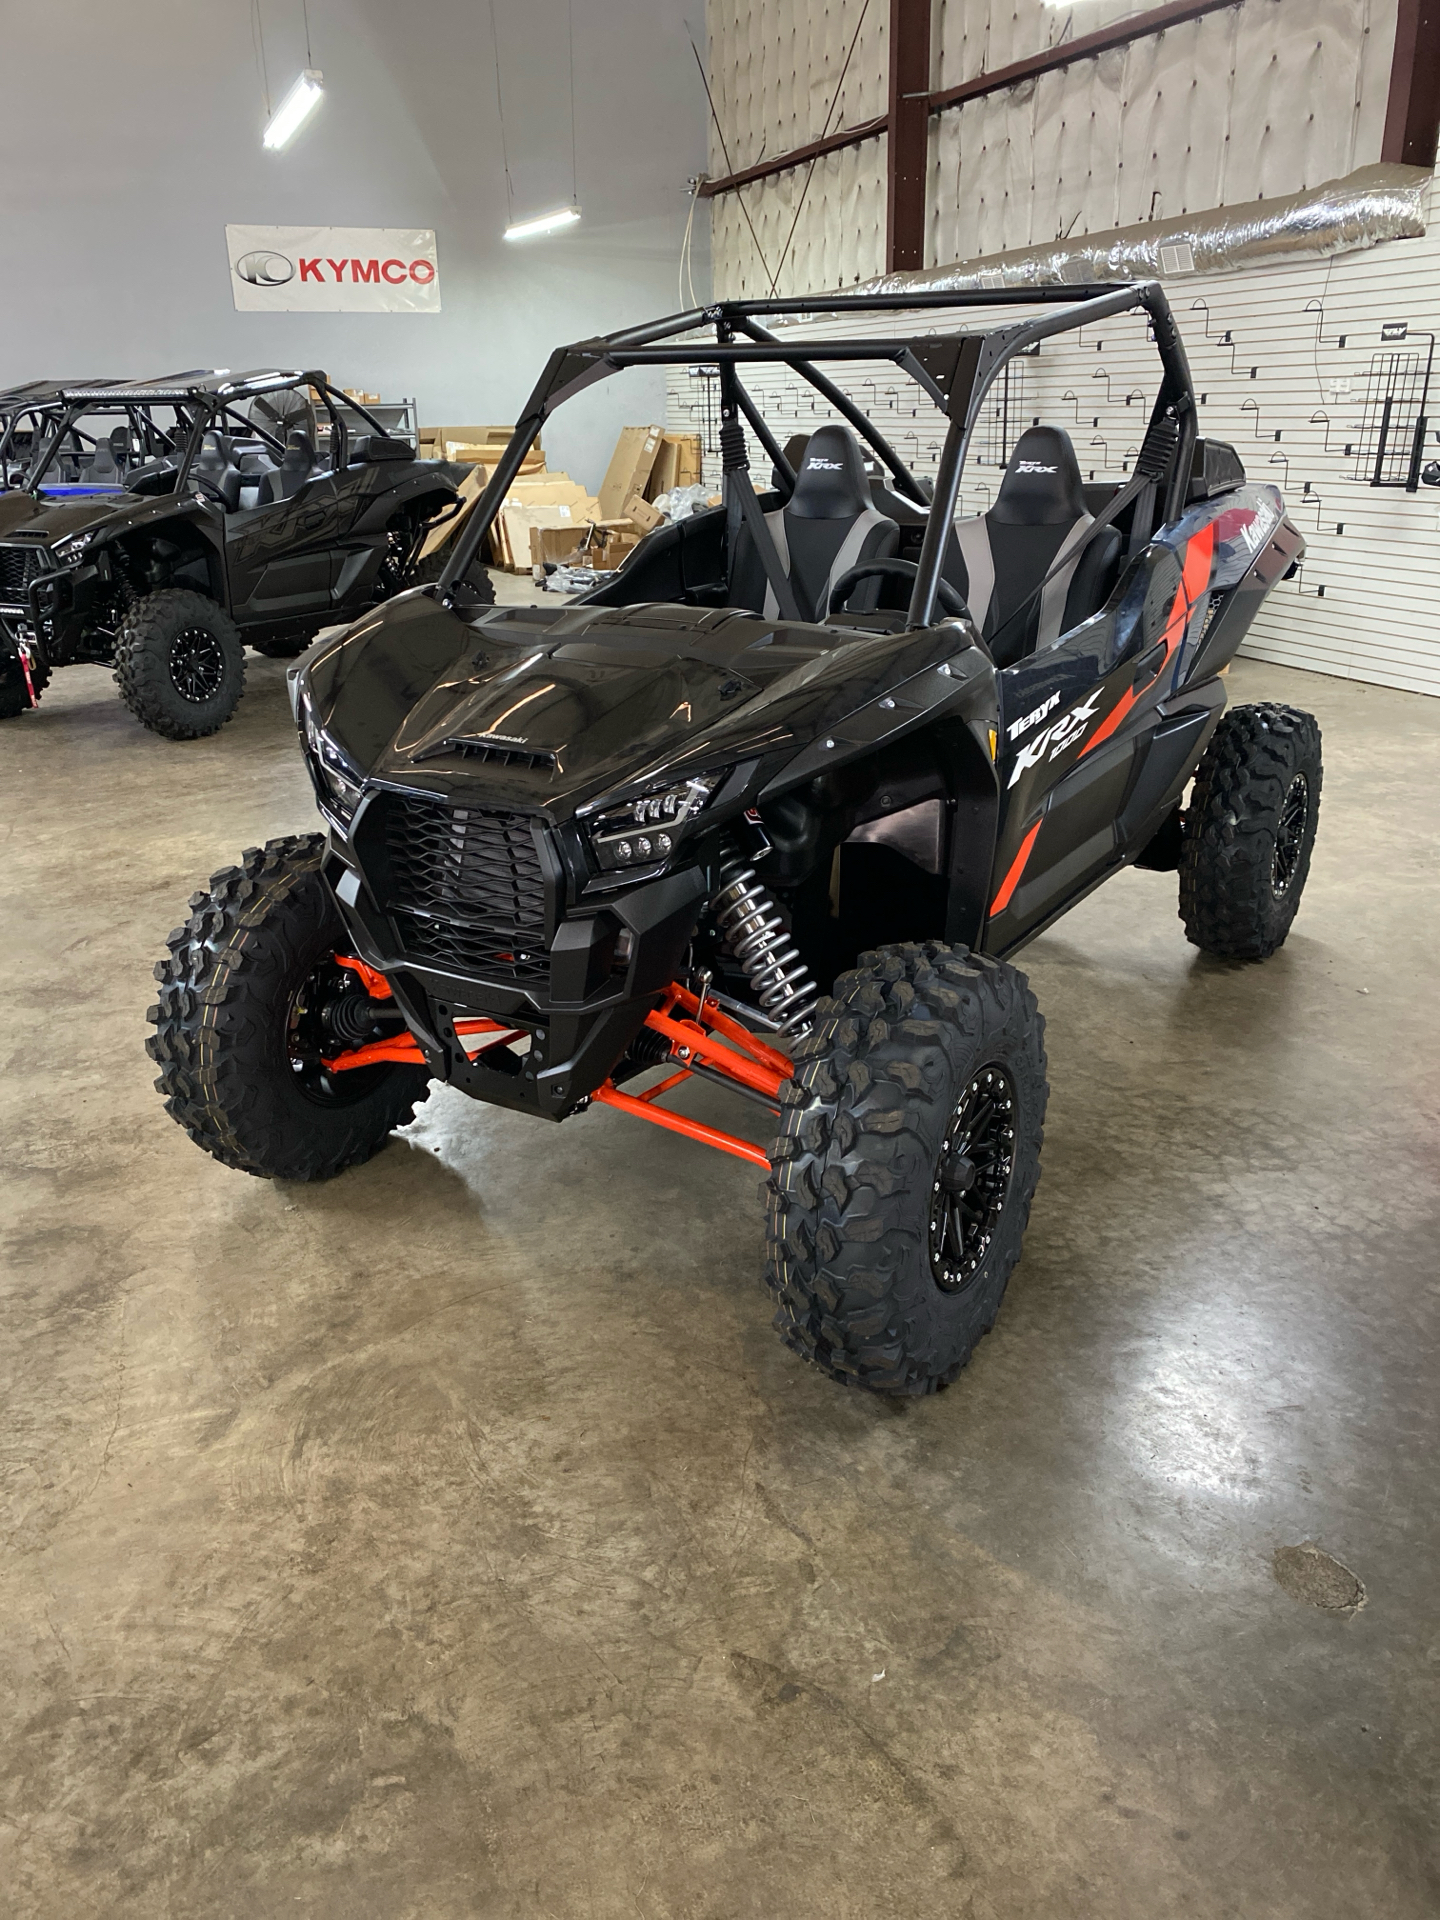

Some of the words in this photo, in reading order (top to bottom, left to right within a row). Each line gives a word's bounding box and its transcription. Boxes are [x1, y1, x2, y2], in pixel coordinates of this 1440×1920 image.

[298, 258, 435, 285] KYMCO
[806, 462, 844, 470] KRX
[1240, 498, 1275, 554] Kawasaki
[478, 732, 528, 744] Kawasaki
[1007, 686, 1105, 790] KRX
